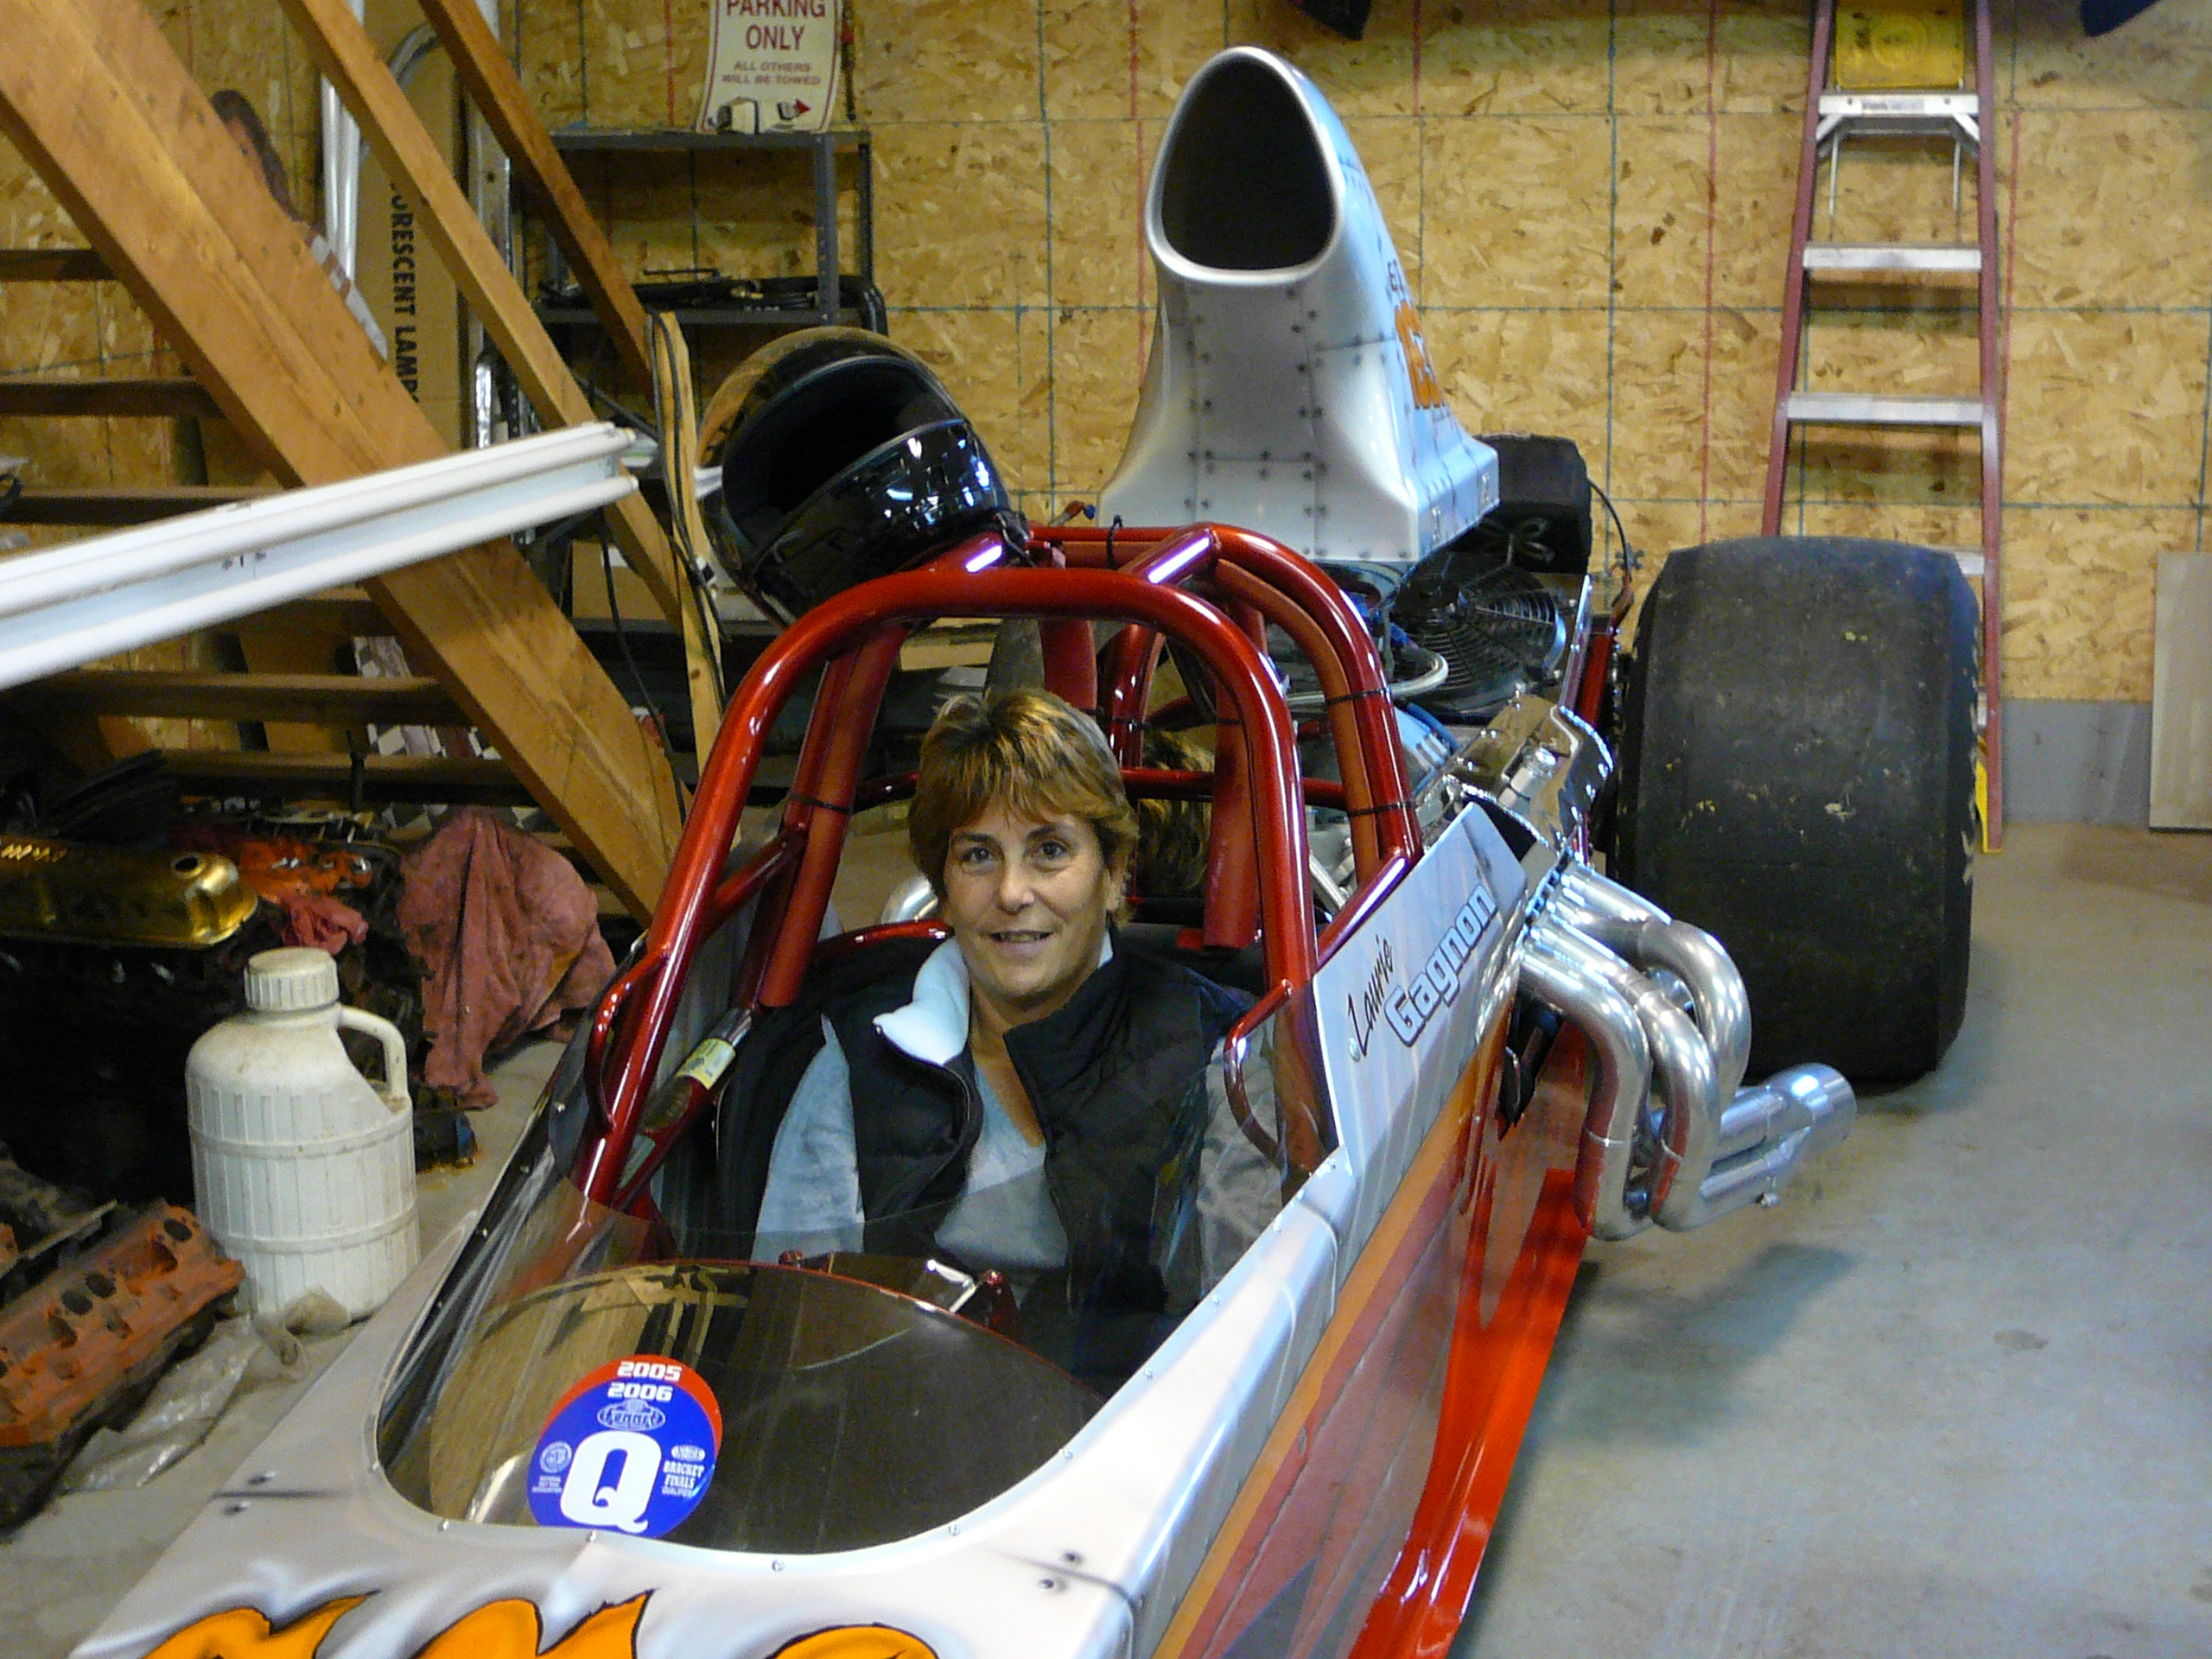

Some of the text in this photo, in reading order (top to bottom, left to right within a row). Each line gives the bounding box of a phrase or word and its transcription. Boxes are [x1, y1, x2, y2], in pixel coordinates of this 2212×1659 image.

[727, 0, 825, 17] PARKING
[746, 24, 804, 50] ONLY
[1384, 884, 1498, 1047] Gagnon
[617, 1361, 683, 1382] 2005
[607, 1382, 673, 1402] 2006
[663, 1460, 705, 1478] BRACKET
[560, 1430, 662, 1534] Q
[664, 1474, 696, 1489] FINALS
